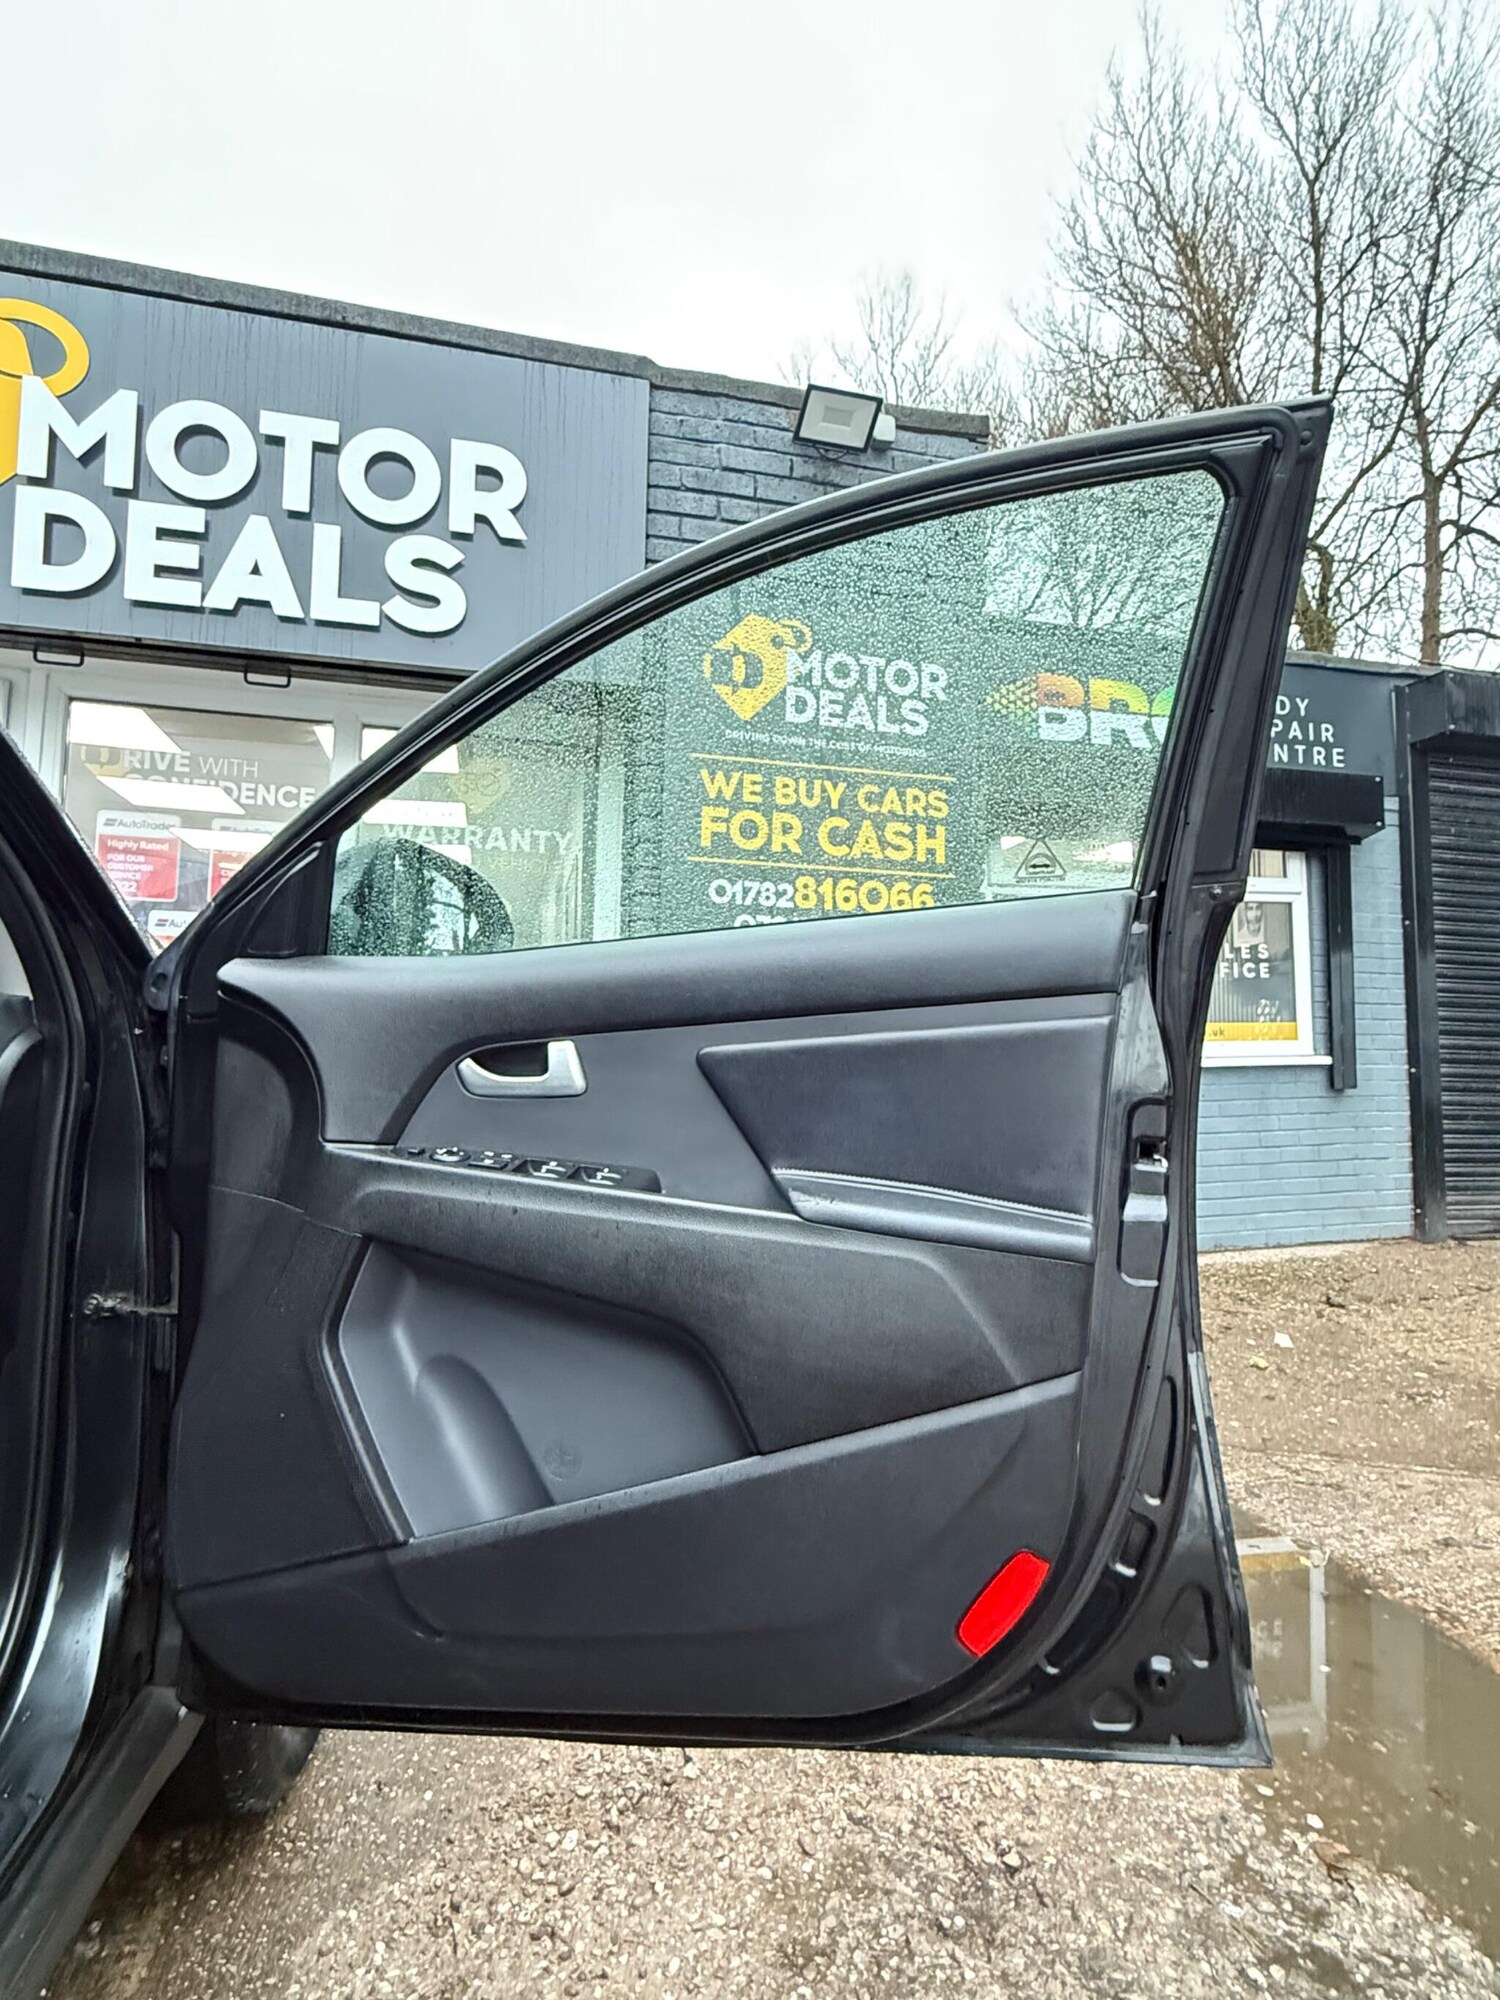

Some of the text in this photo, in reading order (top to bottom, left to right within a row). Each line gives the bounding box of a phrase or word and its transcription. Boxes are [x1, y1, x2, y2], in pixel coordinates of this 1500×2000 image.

[16, 374, 528, 542] MOTOR
[11, 485, 467, 633] DEALS
[786, 650, 950, 700] MOTOR
[785, 685, 930, 736] DEALS
[1275, 695, 1309, 717] DY
[1270, 718, 1335, 743] PAIR
[199, 756, 259, 779] WITH
[1273, 743, 1346, 768] NTRE
[700, 769, 950, 819] WE BUY CARS
[383, 824, 574, 854] WARRANTY
[700, 806, 948, 864] FOR CASH
[1224, 943, 1269, 959] LES
[1219, 961, 1270, 979] FICE
